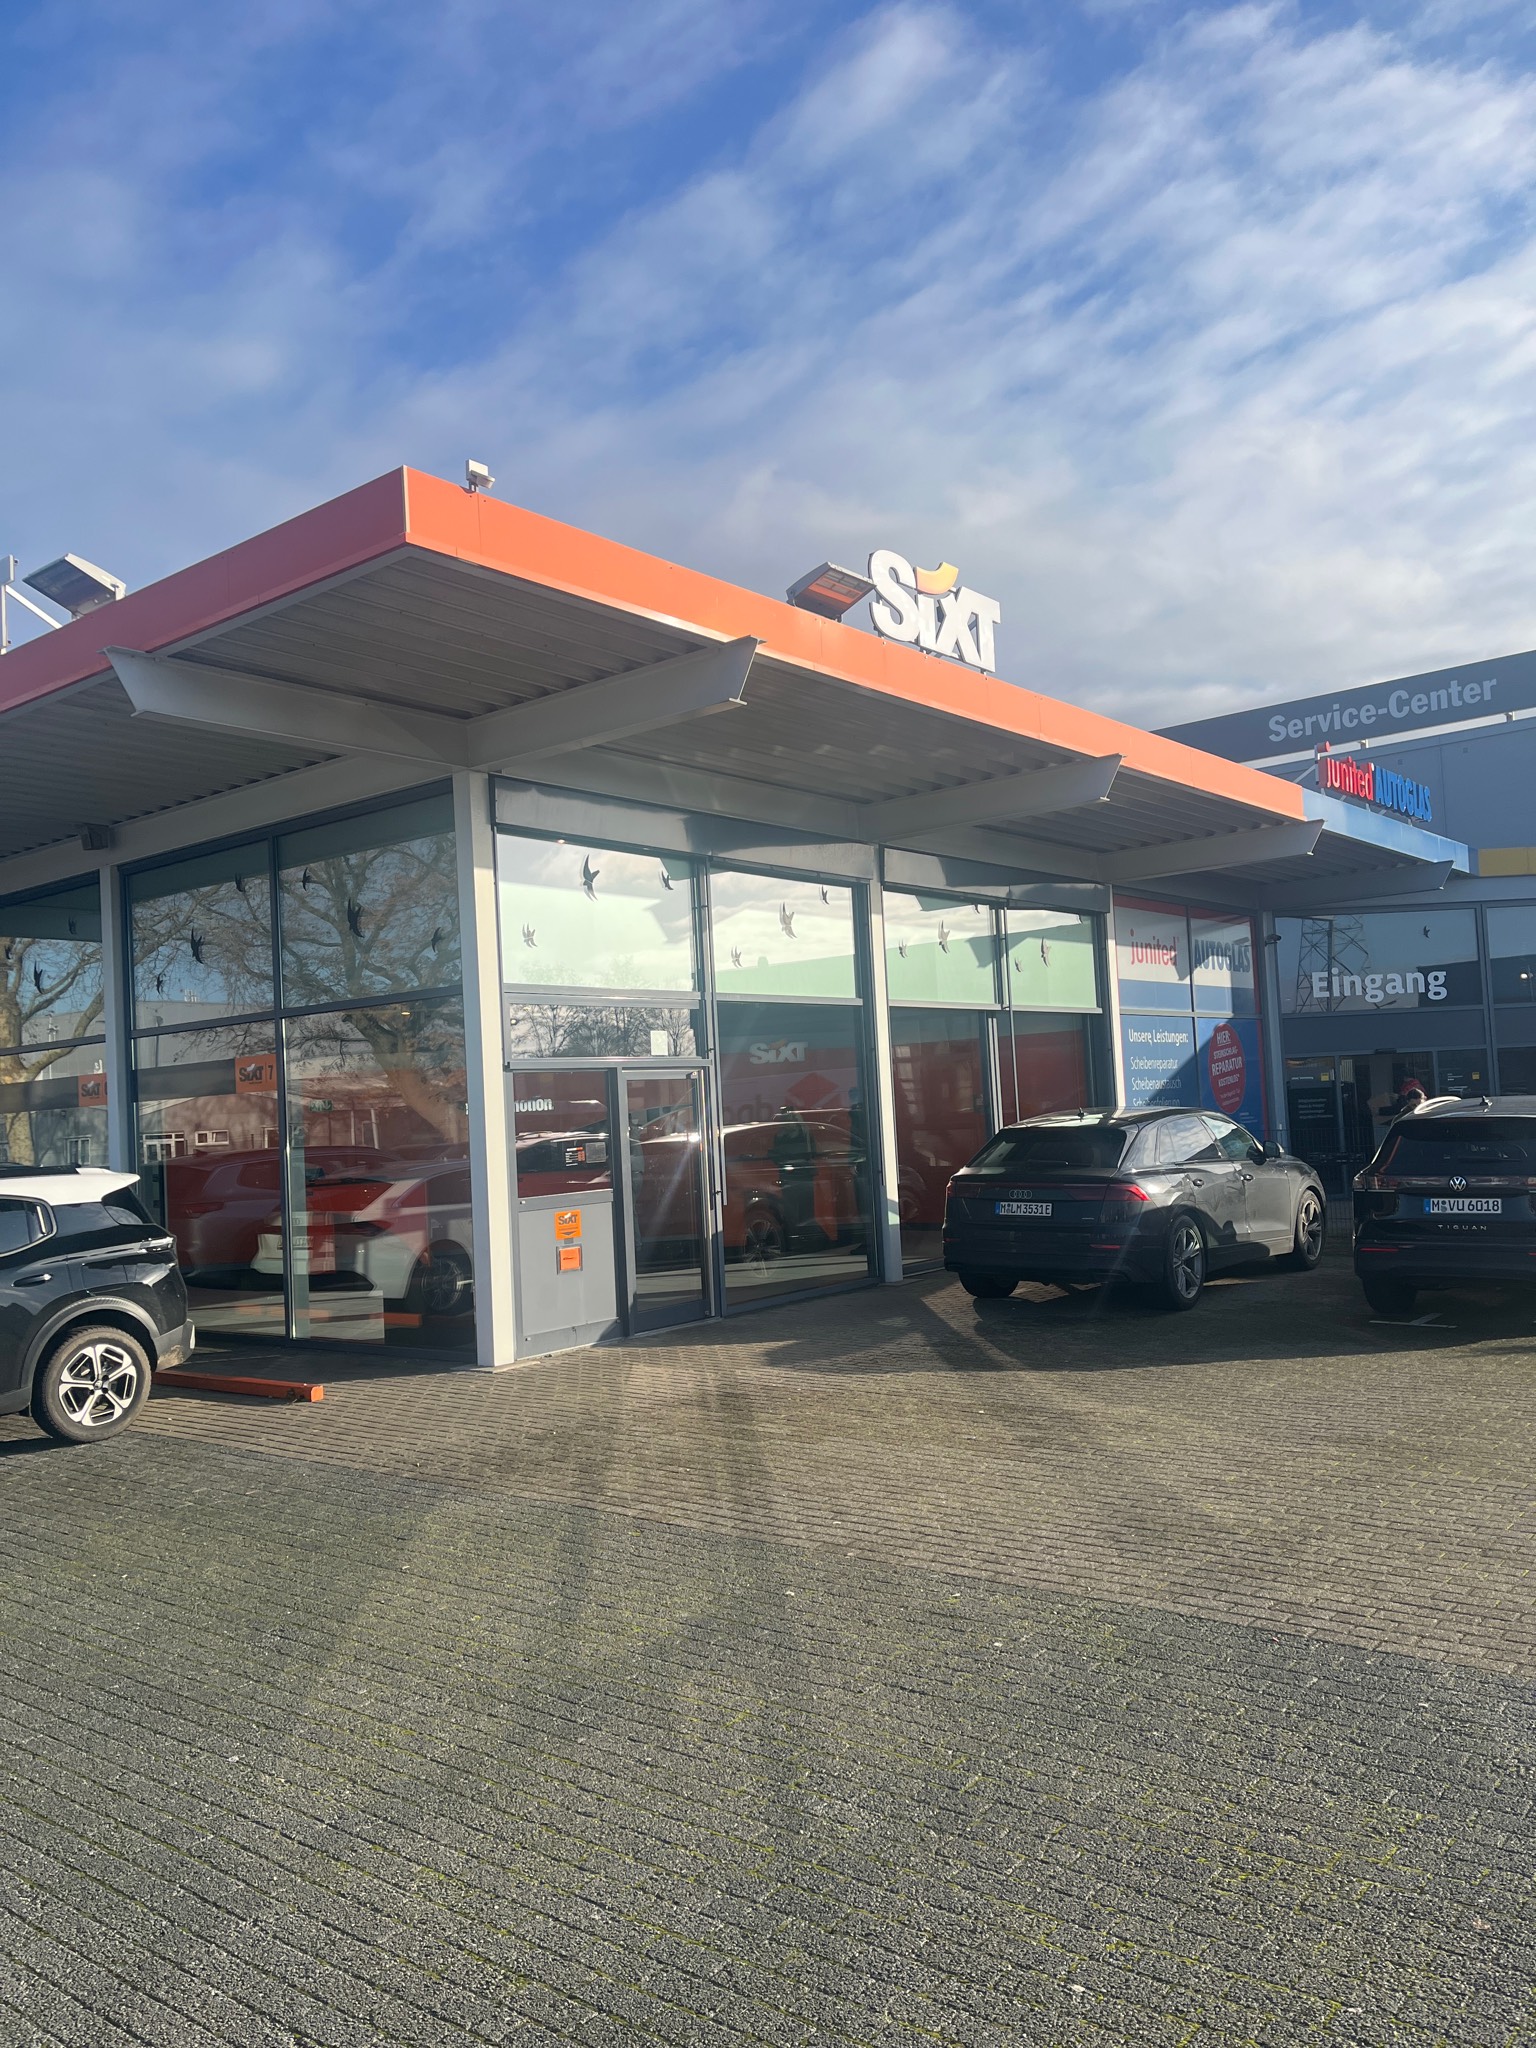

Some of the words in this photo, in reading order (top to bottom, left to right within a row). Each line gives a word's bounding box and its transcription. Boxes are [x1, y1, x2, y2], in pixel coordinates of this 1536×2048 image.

[868, 549, 1000, 672] SIXT
[1268, 678, 1497, 742] Service-Center
[1318, 741, 1374, 801] junited
[1375, 766, 1432, 822] AUTOGLAS
[1130, 928, 1177, 966] junited
[1194, 938, 1250, 973] AUTOGLAS
[1311, 967, 1448, 1003] Eingang
[1128, 1029, 1152, 1043] Unsere
[1152, 1029, 1188, 1046] Leistungen:
[268, 1065, 273, 1080] 7
[1130, 1056, 1178, 1072] Scheibenreparatur
[1211, 1056, 1243, 1076] REPARATUR
[1131, 1077, 1182, 1091] Scheibenaustausch
[1467, 1200, 1500, 1212] 6018
